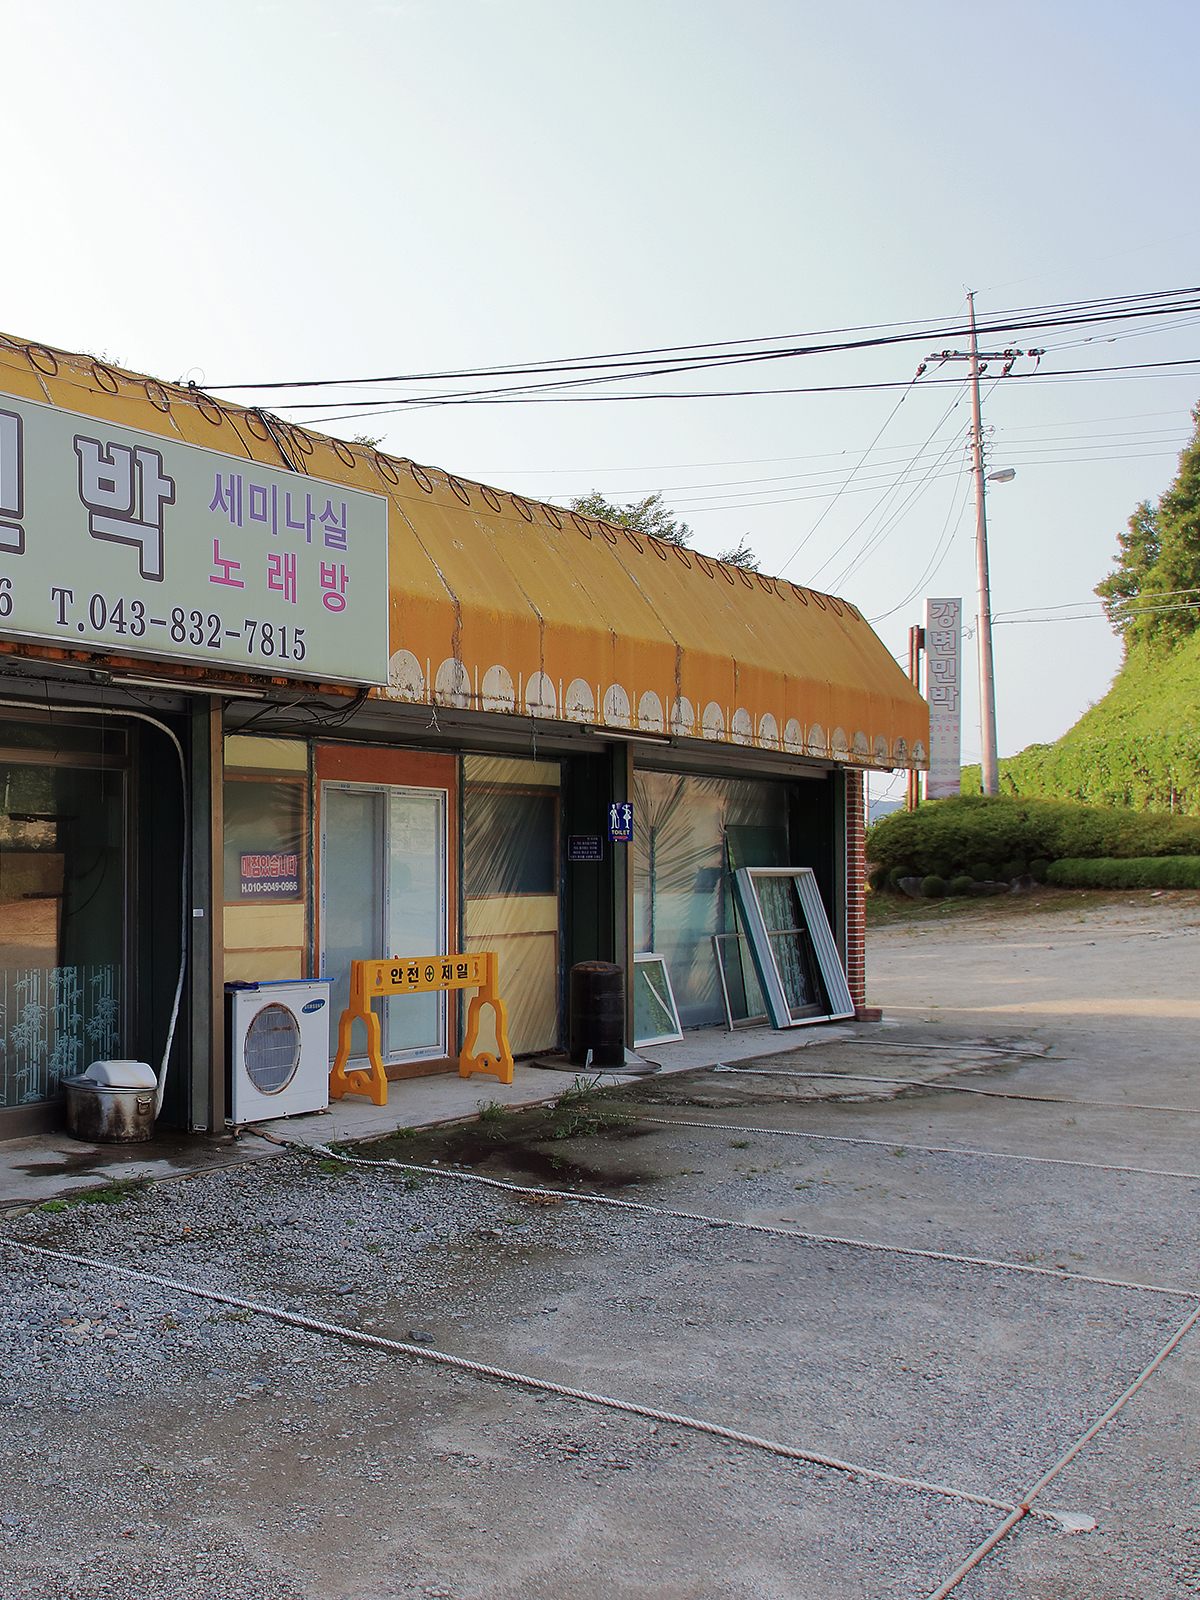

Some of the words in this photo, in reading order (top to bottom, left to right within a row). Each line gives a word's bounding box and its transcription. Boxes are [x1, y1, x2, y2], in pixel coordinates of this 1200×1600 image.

[209, 471, 350, 552] 세미나실
[209, 537, 352, 614] 노래방
[50, 586, 309, 662] T.043-832-7815
[930, 601, 959, 712] 강변민박
[241, 855, 297, 877] 매점있습니다
[241, 881, 298, 893] H.010-5049-0966
[390, 966, 419, 984] 안전
[441, 963, 468, 980] 제일
